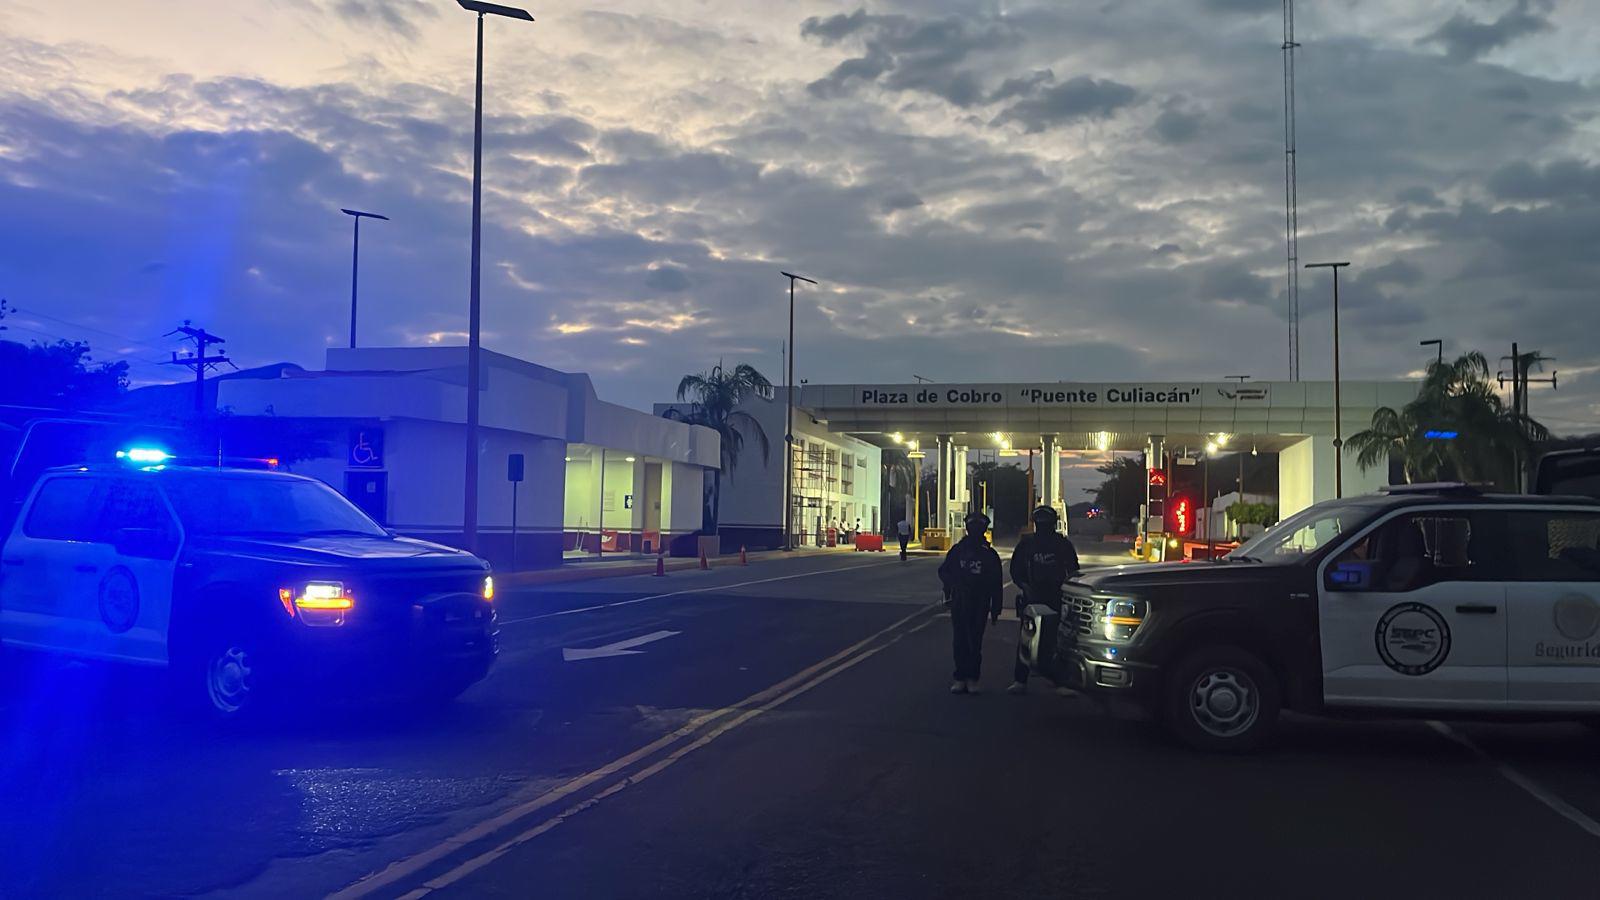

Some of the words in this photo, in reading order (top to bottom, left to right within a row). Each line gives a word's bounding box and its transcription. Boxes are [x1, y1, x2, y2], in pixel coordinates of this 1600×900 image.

[862, 389, 908, 404] Plaza
[916, 389, 939, 404] de
[946, 389, 1002, 404] Cobro
[1020, 389, 1098, 403] “Puente
[1106, 387, 1200, 403] Culiacán”
